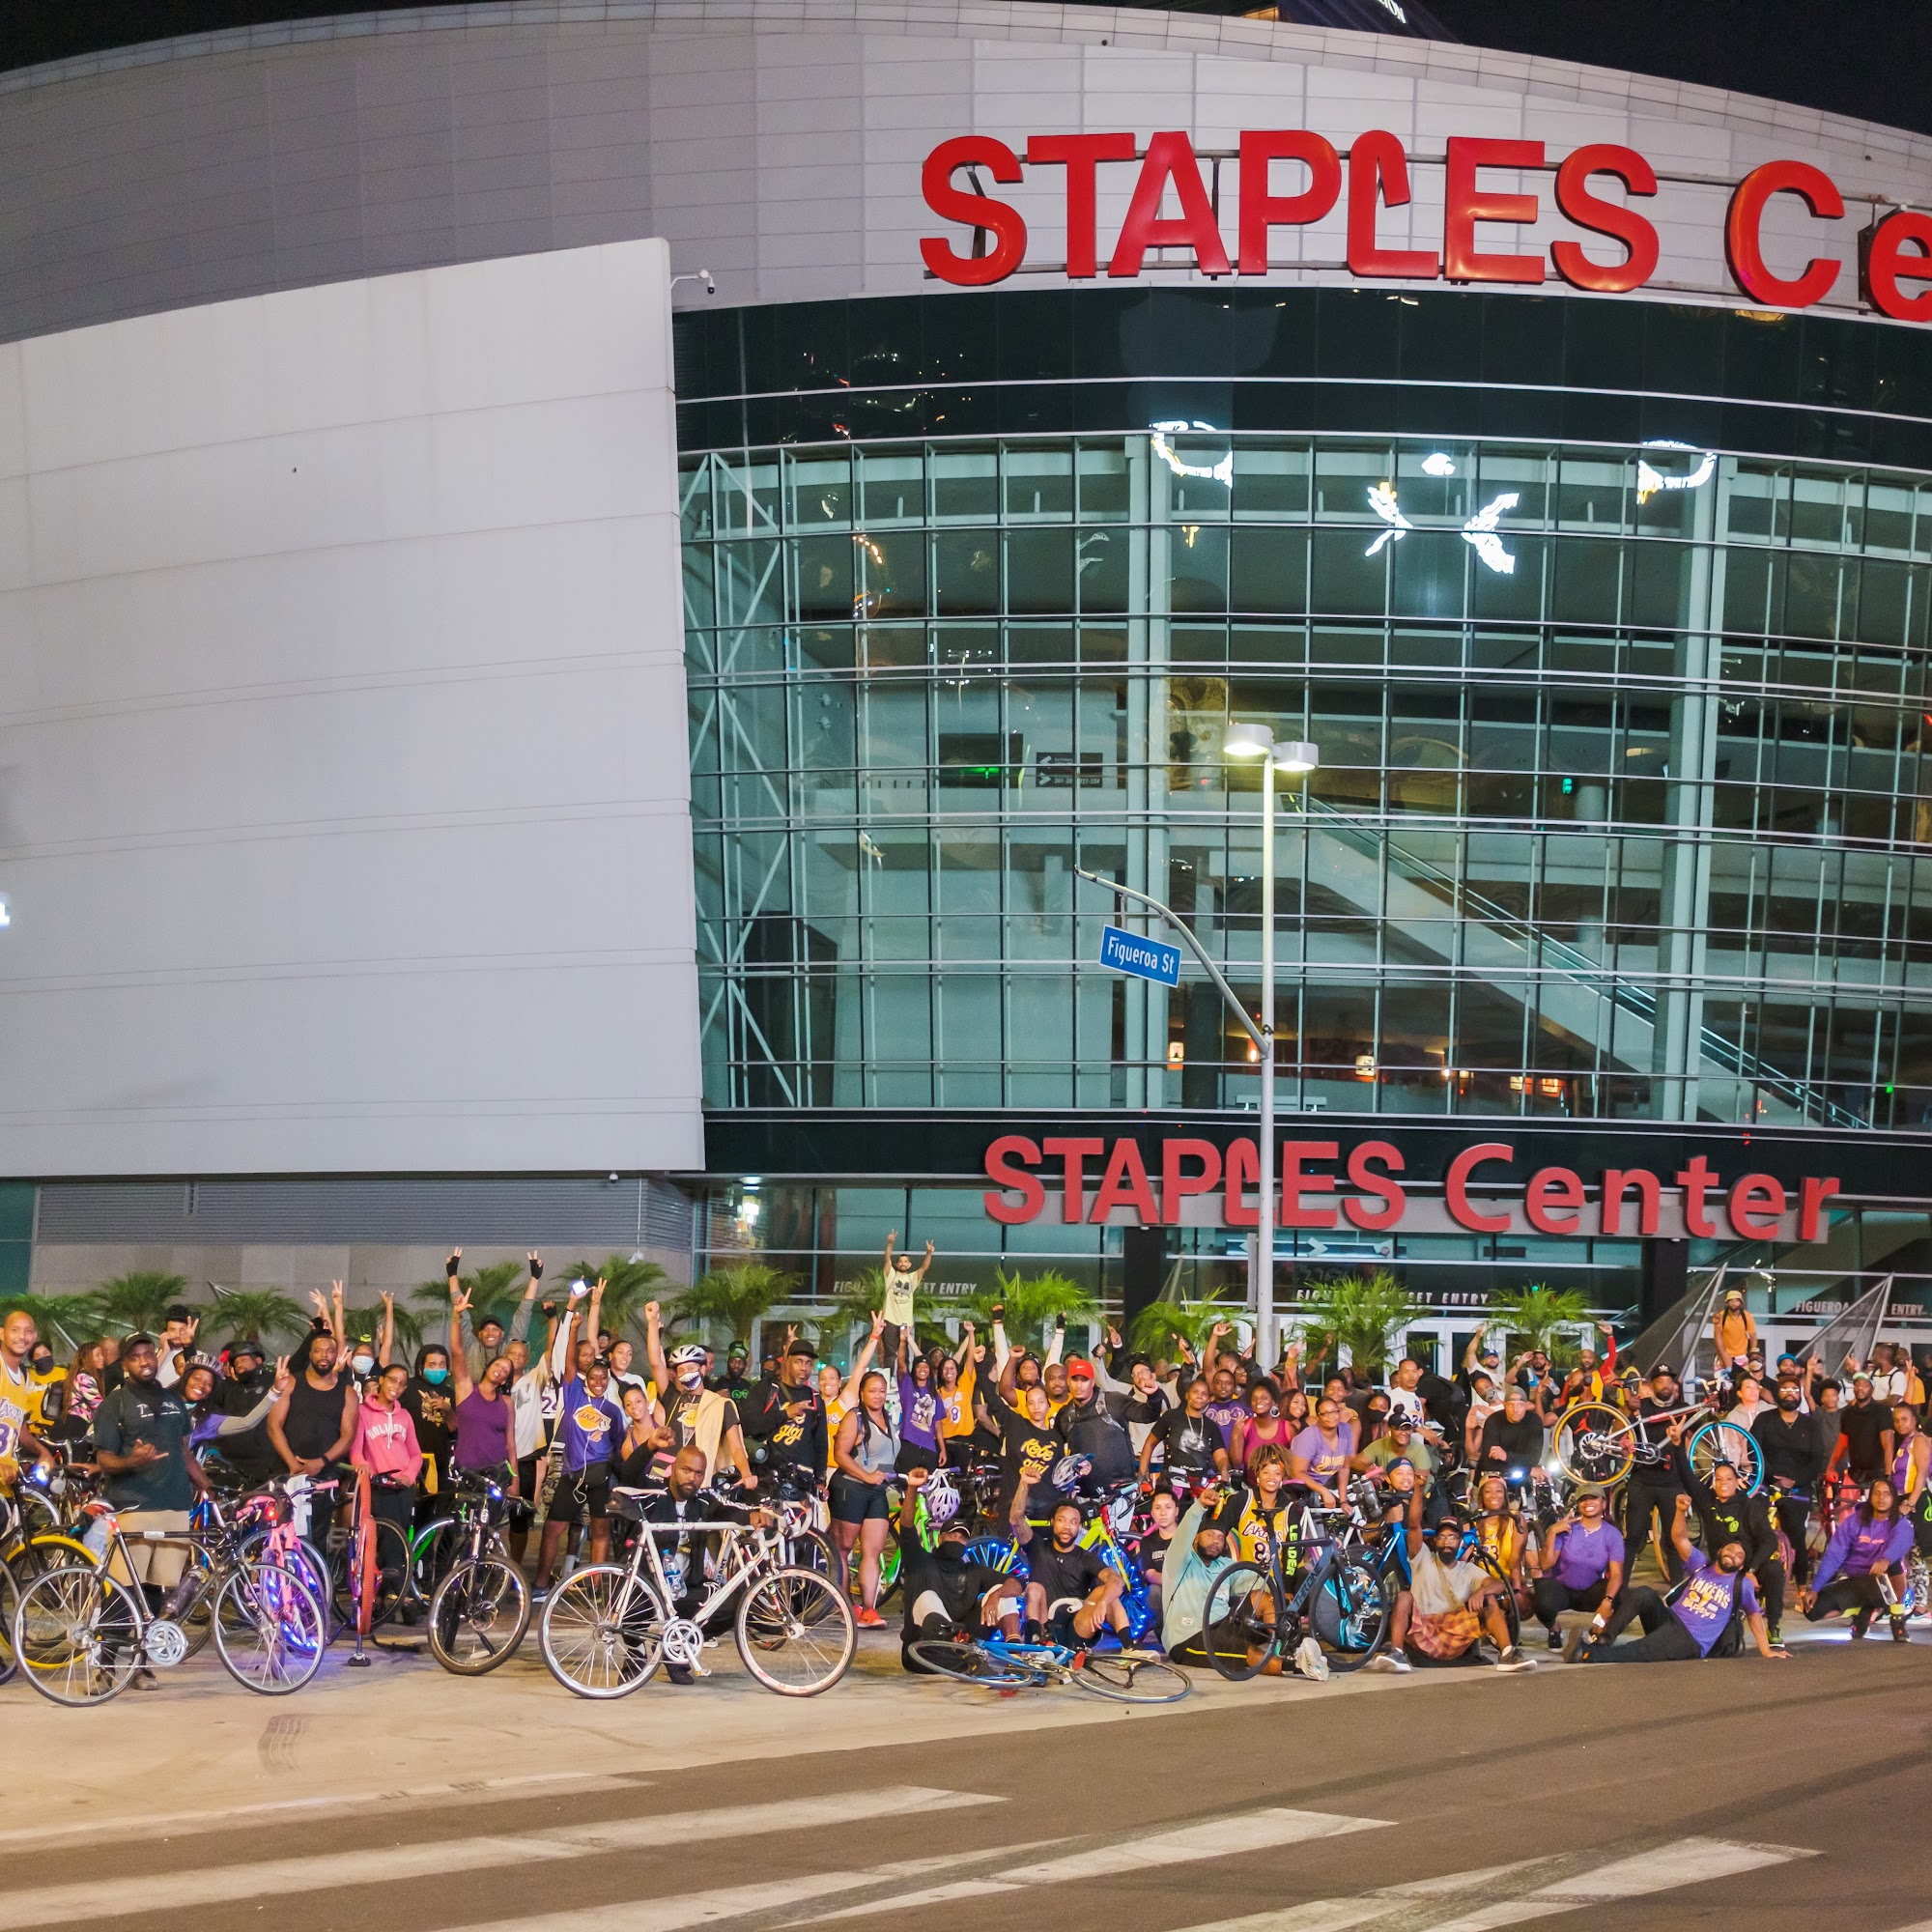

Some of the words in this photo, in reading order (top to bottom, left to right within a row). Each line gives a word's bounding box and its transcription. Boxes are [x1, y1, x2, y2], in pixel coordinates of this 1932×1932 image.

[920, 129, 1660, 294] STAPLES
[1107, 935, 1158, 970] Figueroa
[1161, 952, 1175, 975] St
[983, 1135, 1406, 1231] STAPLES
[1446, 1144, 1841, 1242] Center
[939, 1283, 978, 1295] ENTRY
[1441, 1293, 1489, 1305] ENTRY
[1890, 1303, 1924, 1316] ENTRY
[952, 1406, 959, 1421] 8
[1414, 1400, 1421, 1412] 8
[773, 1424, 805, 1446] gigi
[715, 1558, 726, 1584] GIANT
[1294, 1563, 1322, 1606] THRONE
[1689, 1578, 1731, 1609] LAKERS
